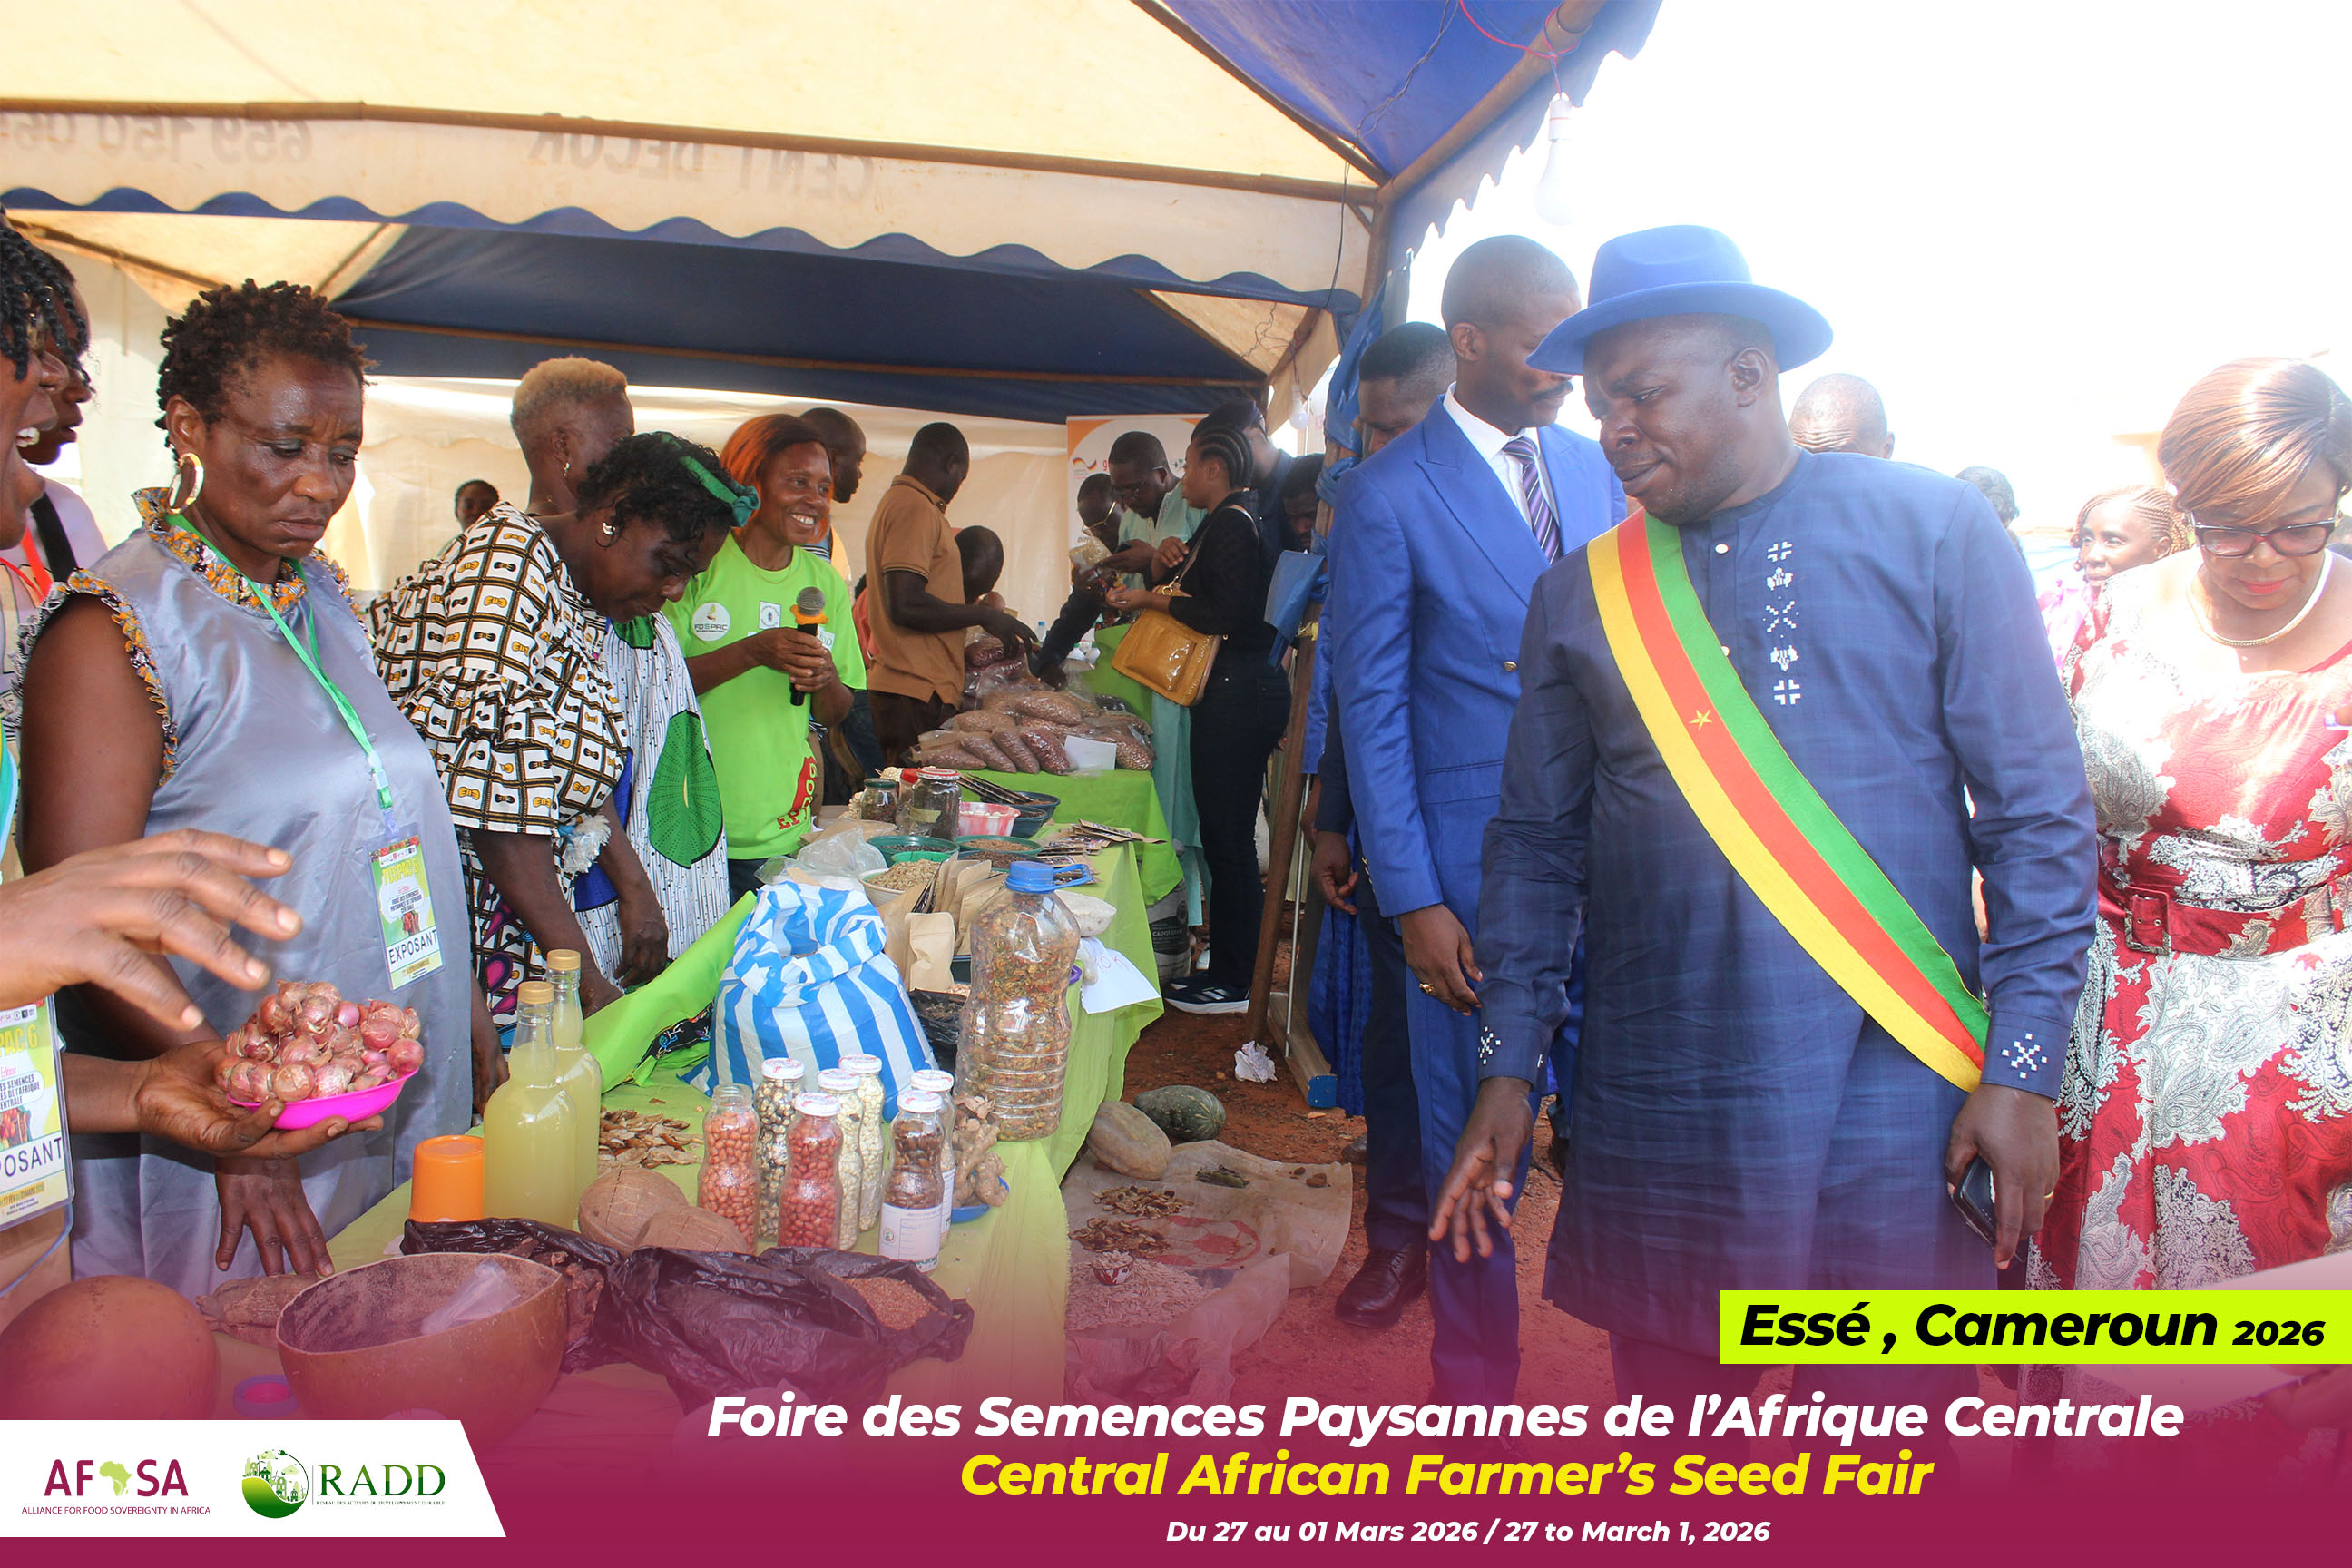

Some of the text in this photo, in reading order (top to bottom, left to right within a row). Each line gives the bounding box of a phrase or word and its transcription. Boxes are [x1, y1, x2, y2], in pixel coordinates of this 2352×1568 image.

[388, 929, 437, 965] EXPOSANT
[27, 1024, 38, 1049] 6
[7, 1073, 35, 1089] SEMENCES
